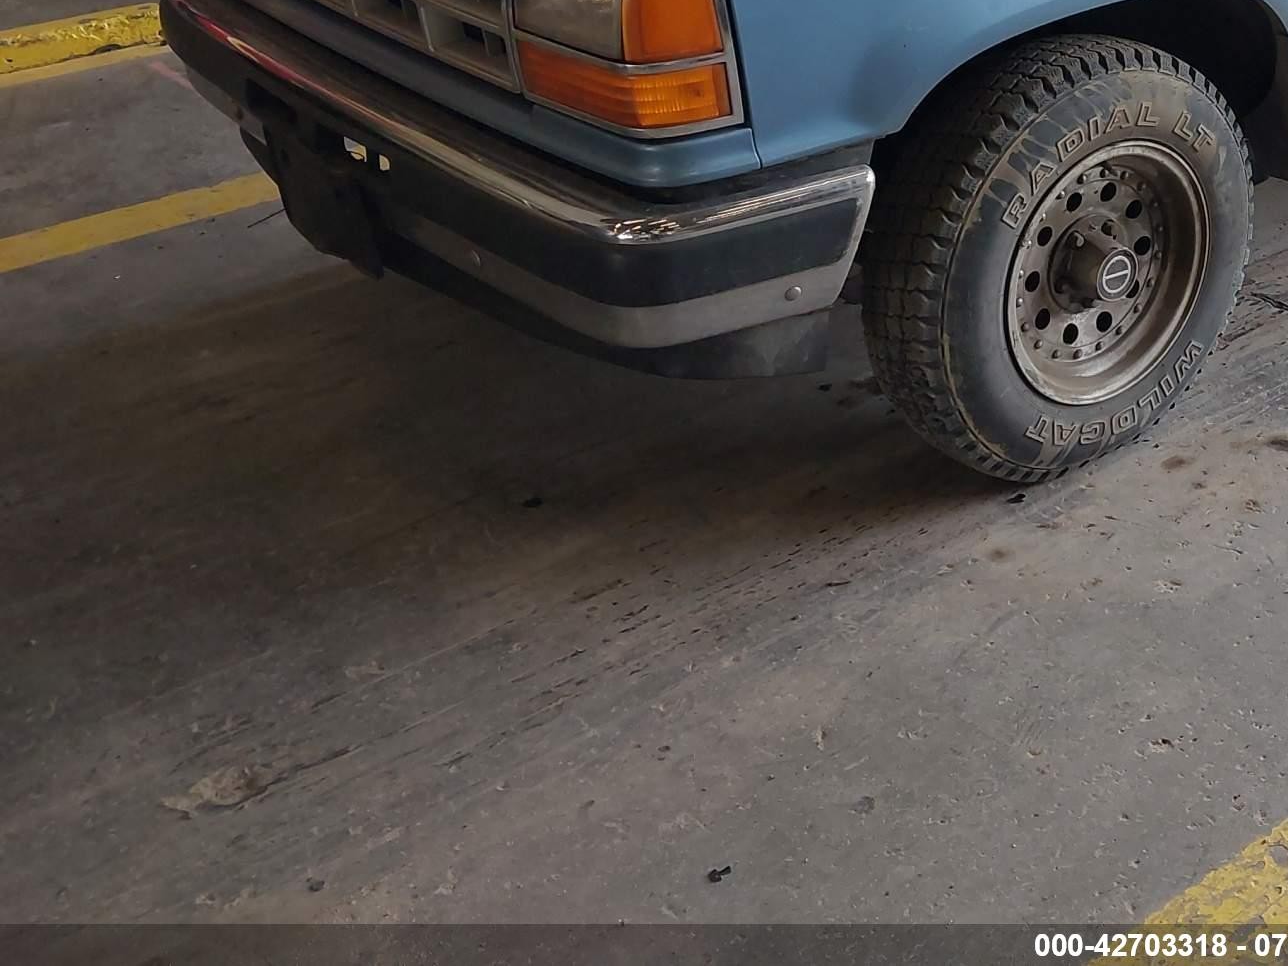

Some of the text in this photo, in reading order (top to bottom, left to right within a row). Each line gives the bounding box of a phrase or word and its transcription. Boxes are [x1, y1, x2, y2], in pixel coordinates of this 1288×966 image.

[1002, 101, 1216, 229] RADIAL LT
[1025, 339, 1205, 447] WILDCAT
